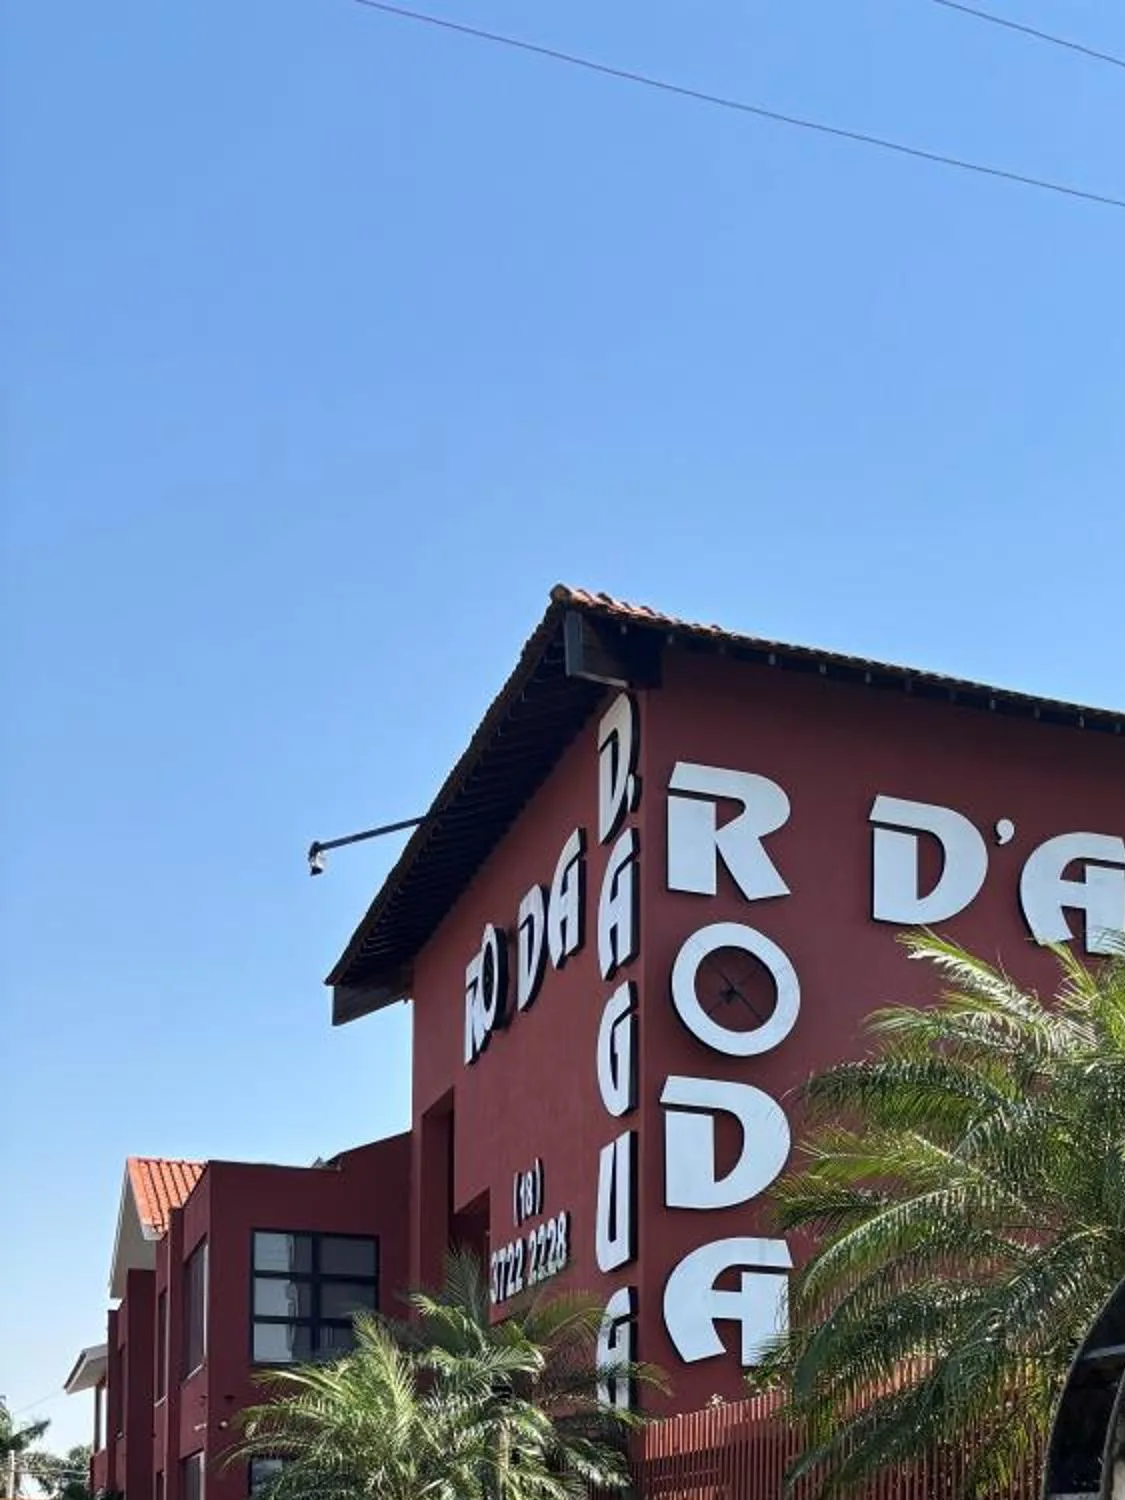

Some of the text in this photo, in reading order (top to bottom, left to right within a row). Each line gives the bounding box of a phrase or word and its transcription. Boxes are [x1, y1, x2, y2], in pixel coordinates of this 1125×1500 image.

[660, 761, 801, 1366] RODA
[513, 1157, 541, 1227] (18)
[489, 1210, 567, 1304] 3722 2228
